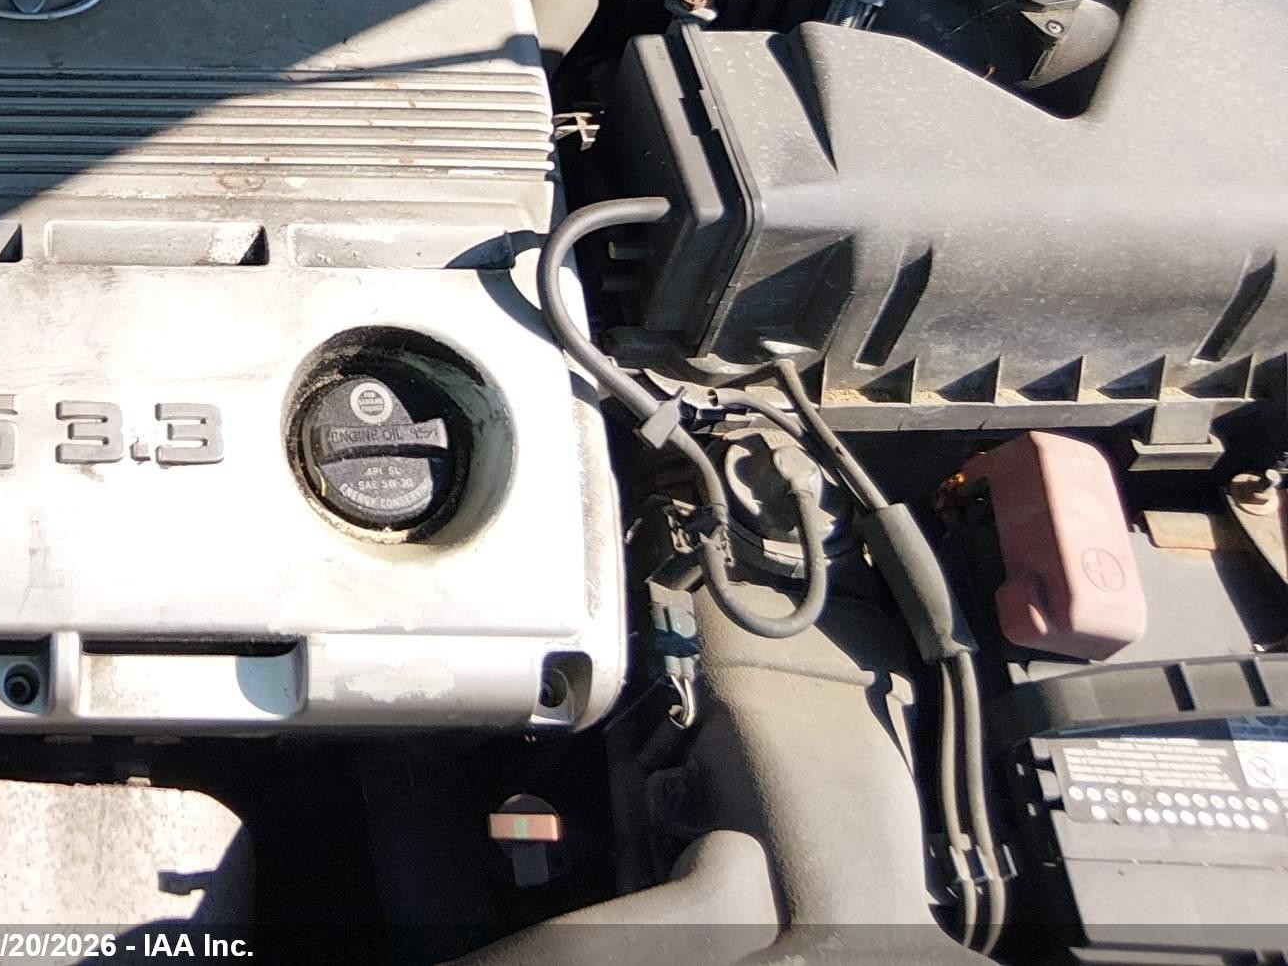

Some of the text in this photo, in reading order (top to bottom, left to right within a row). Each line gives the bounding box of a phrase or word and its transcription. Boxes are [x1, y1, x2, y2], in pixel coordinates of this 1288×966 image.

[55, 400, 225, 468] 3.3
[329, 428, 403, 443] ENGINE OIL
[365, 465, 402, 476] API SL
[357, 479, 378, 491] SAE
[339, 482, 377, 506] ENERGY
